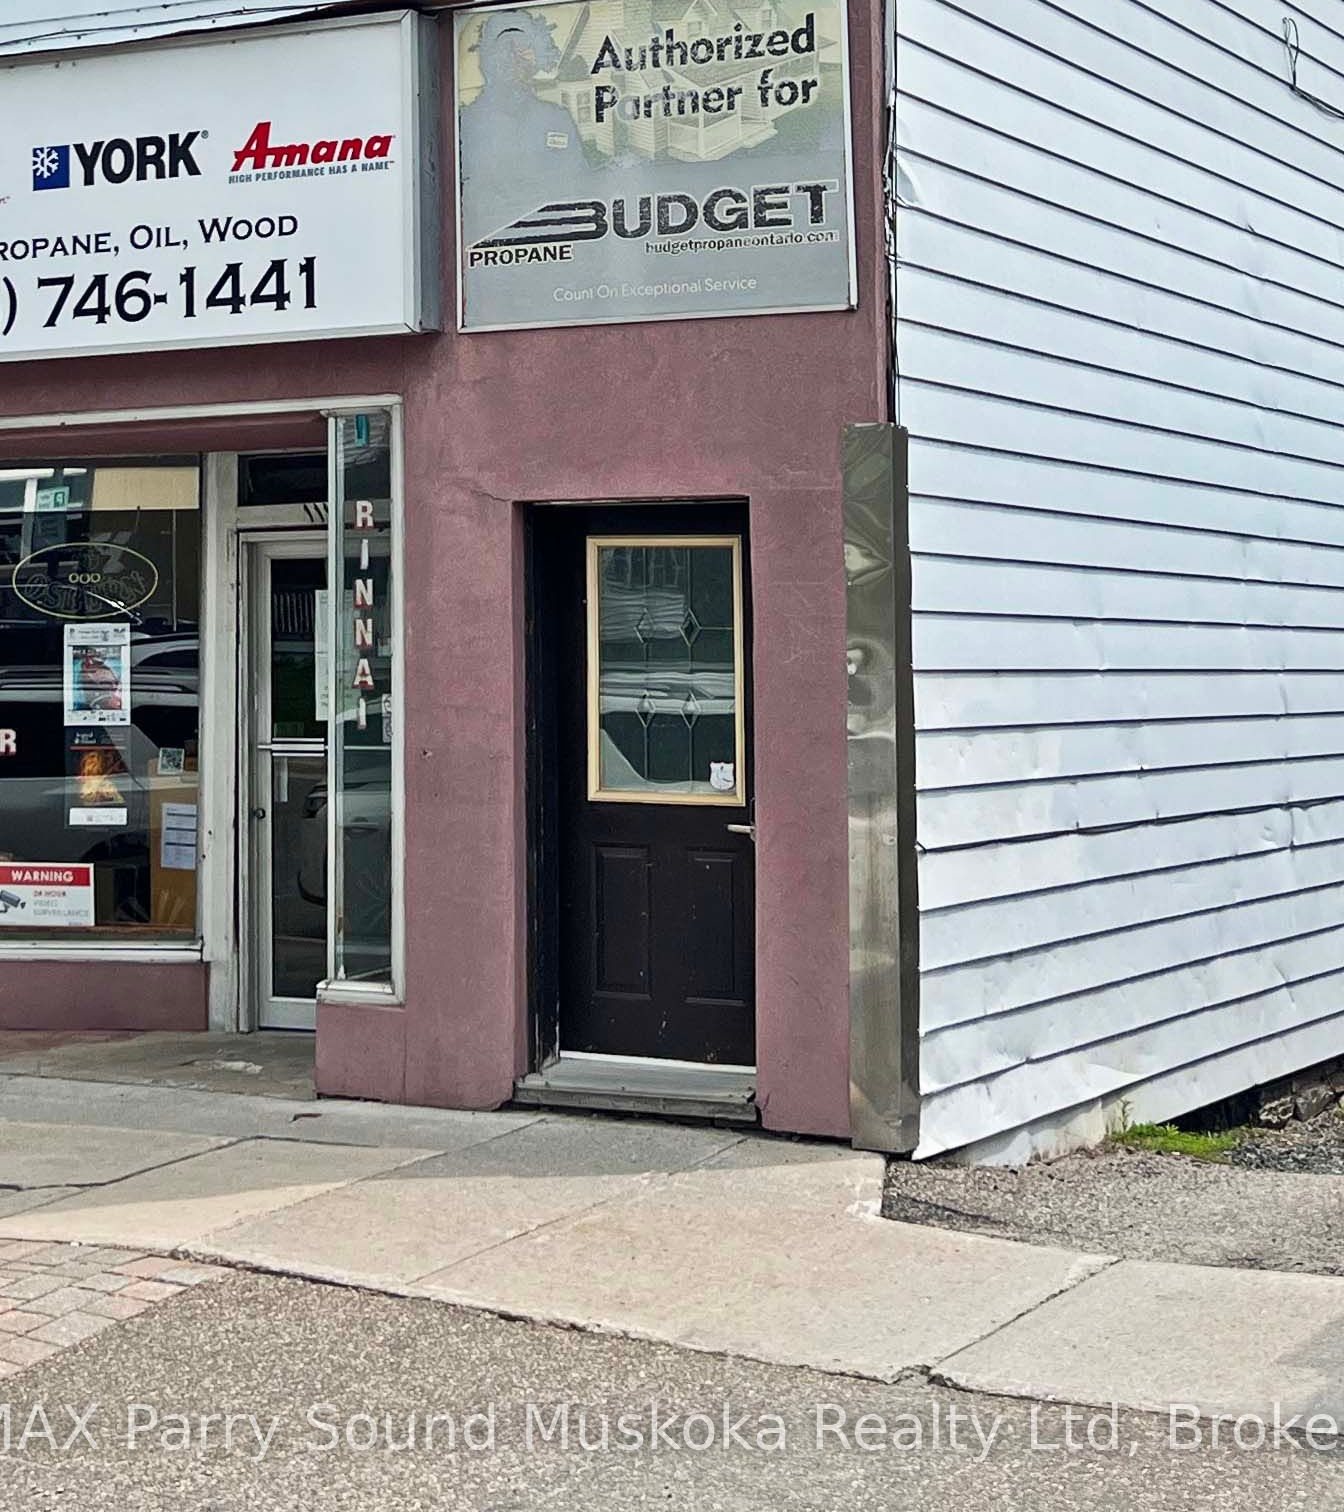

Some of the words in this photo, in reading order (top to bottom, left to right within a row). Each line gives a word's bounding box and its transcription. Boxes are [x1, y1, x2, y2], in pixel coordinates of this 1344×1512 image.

[591, 13, 816, 75] Authorized
[594, 83, 743, 123] Partner
[757, 69, 818, 108] for
[231, 121, 395, 172] Amana
[228, 174, 252, 184] HIGH
[255, 167, 324, 182] PERFORMANCE
[329, 164, 347, 175] HAS
[350, 164, 358, 173] A
[472, 183, 832, 249] BUDGET
[468, 244, 573, 268] PROPANE
[646, 232, 838, 255] budgetpropaneontariocom
[37, 256, 318, 328] 746-1441
[553, 284, 594, 303] Count
[598, 284, 618, 301] On
[621, 278, 703, 300] Exceptional
[704, 275, 758, 294] Service
[353, 500, 376, 729] RINNAI
[11, 869, 74, 882] WARNING
